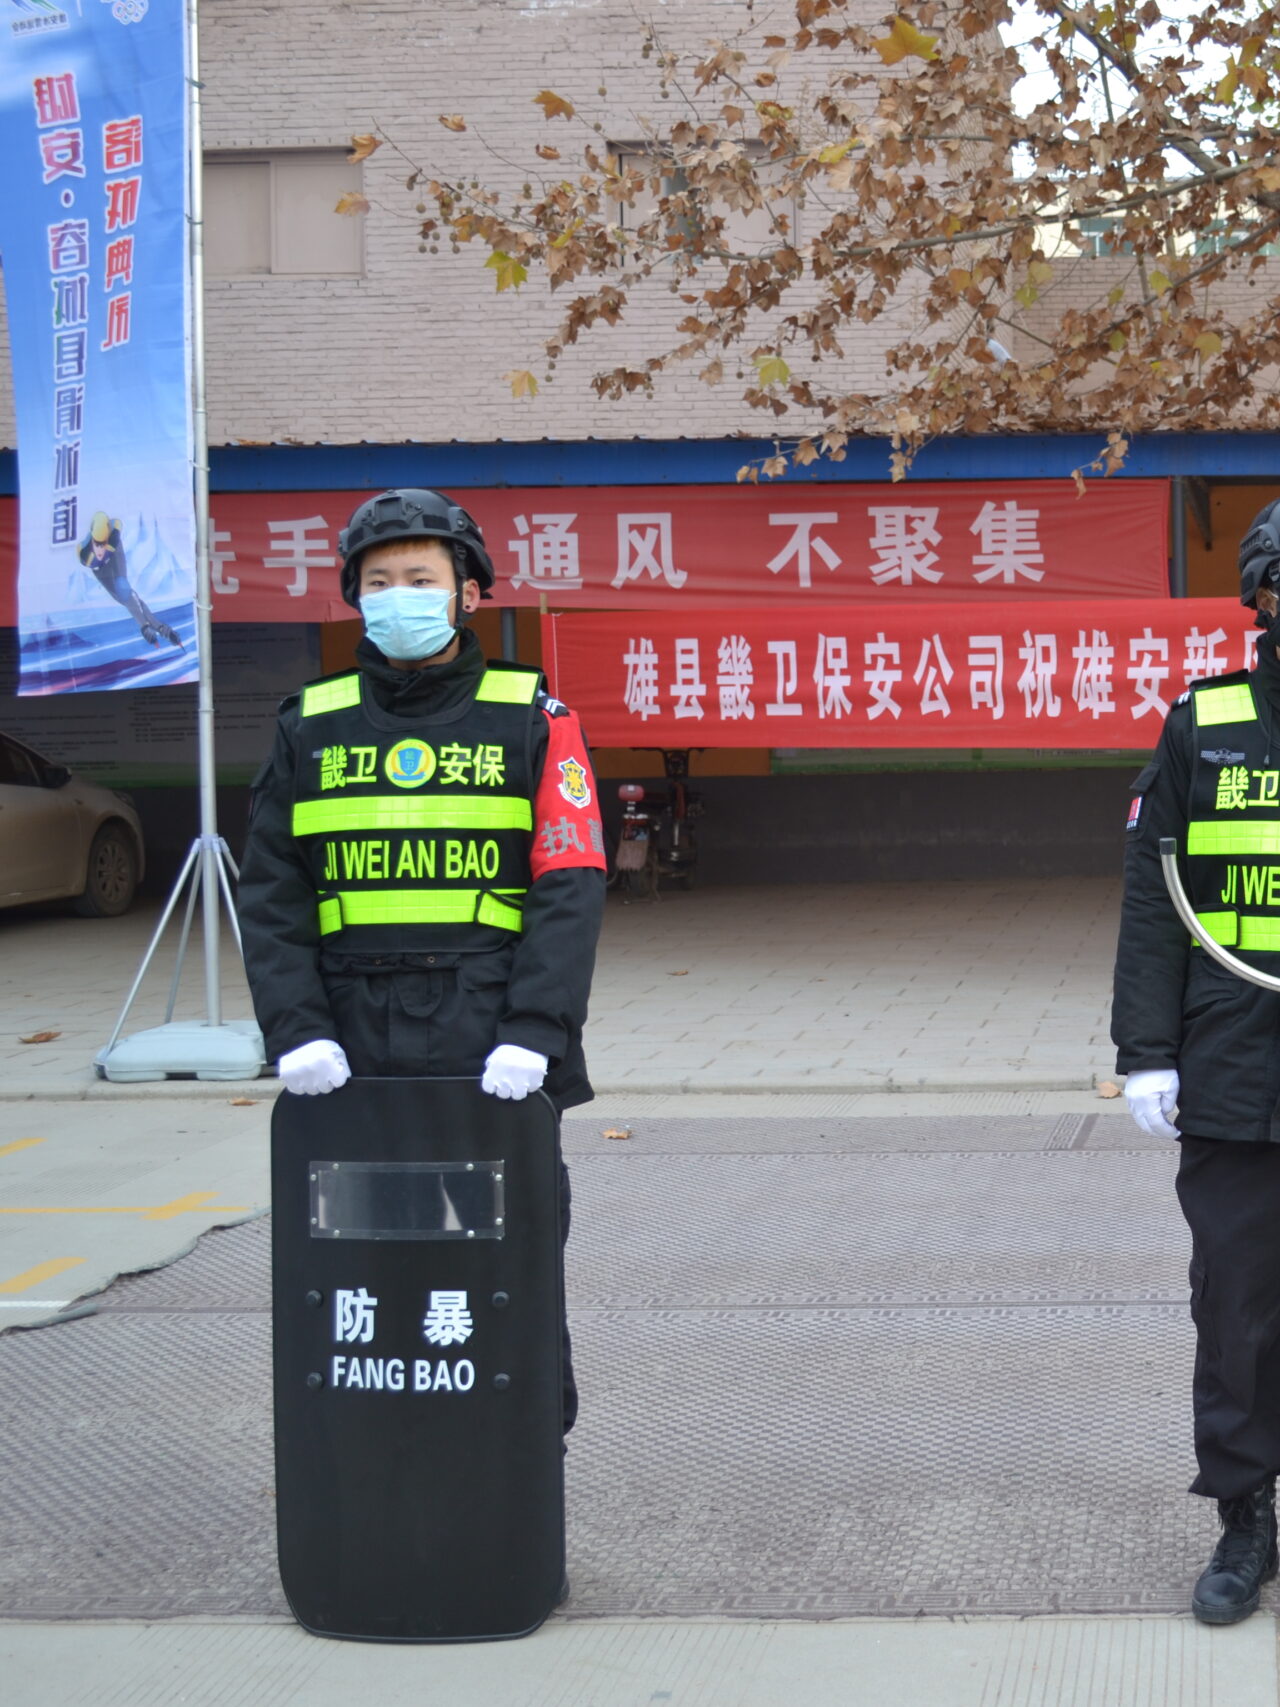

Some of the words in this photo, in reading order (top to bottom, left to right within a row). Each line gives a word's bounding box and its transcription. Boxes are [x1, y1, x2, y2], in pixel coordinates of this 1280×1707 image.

[767, 500, 1045, 589] 不聚集
[438, 742, 505, 786] 安保
[325, 842, 338, 880] JI
[342, 840, 390, 880] WEI
[396, 839, 436, 879] AN
[445, 839, 500, 879] BAO
[1221, 864, 1238, 904] JI
[335, 1287, 474, 1346] 防暴
[332, 1355, 405, 1391] FANG
[414, 1359, 475, 1392] BAO
